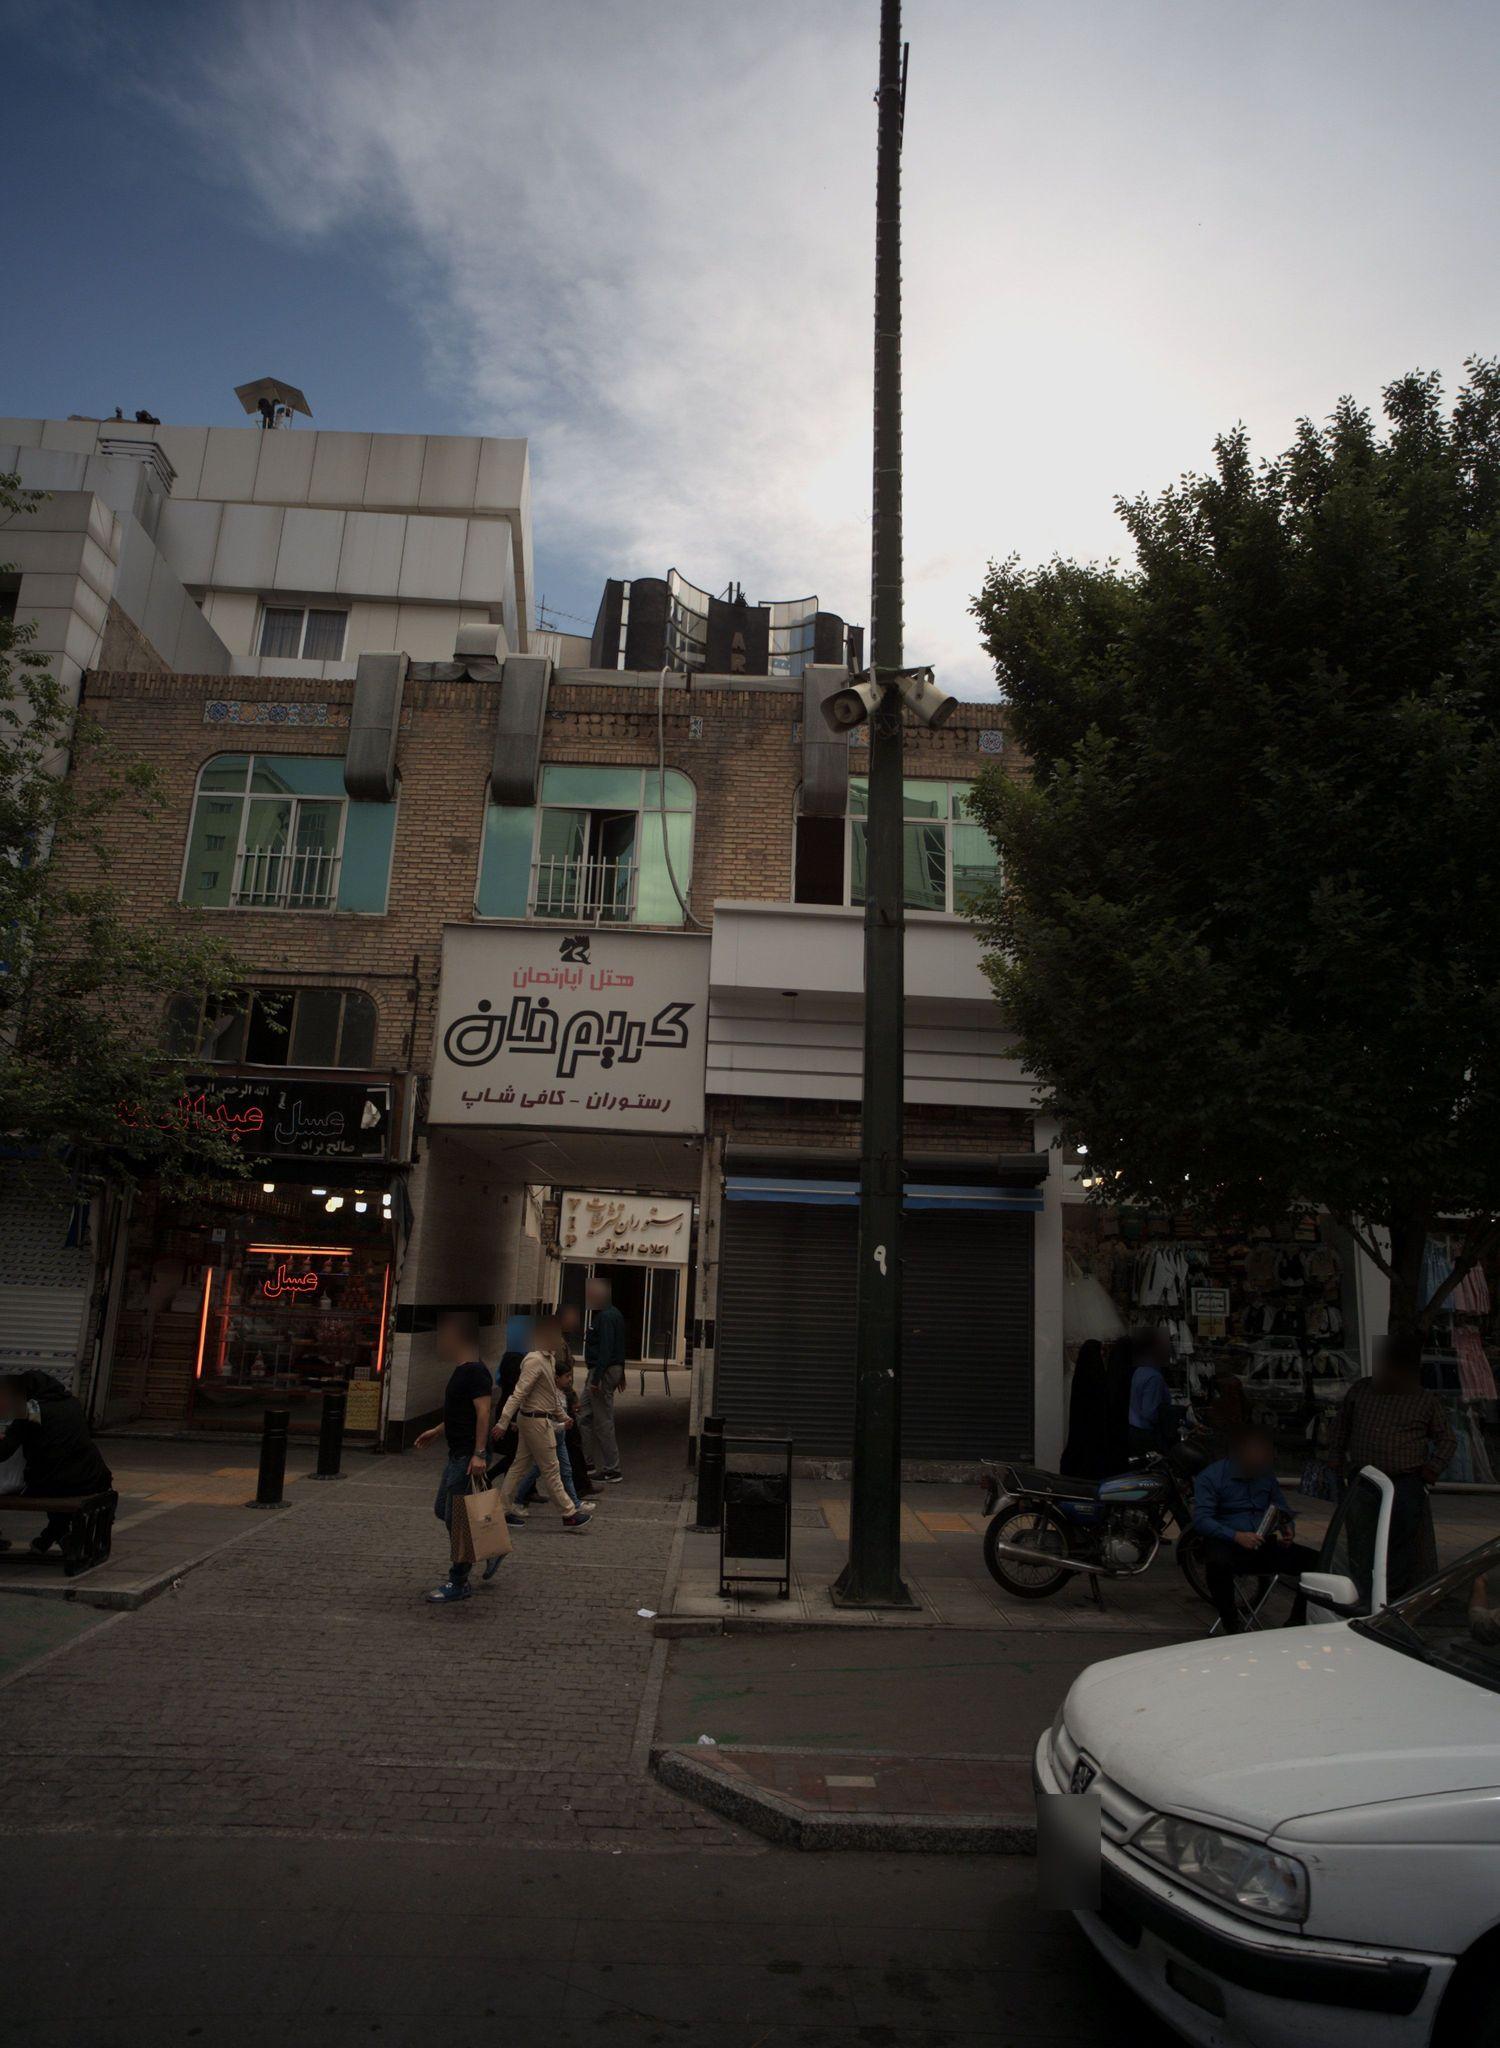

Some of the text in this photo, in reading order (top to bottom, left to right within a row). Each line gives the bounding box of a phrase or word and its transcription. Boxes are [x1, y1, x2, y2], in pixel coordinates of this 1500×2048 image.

[590, 969, 634, 991] هتل
[443, 996, 696, 1078] کریم خان
[461, 1085, 515, 1109] شاپ
[520, 1090, 565, 1108] کافی
[586, 1092, 671, 1113] رستوران
[274, 1100, 345, 1145] عسل
[326, 1140, 355, 1156] صالح
[566, 1198, 580, 1248] VIP
[586, 1197, 684, 1237] رستوران تشریفات
[264, 1264, 318, 1298] عسل
